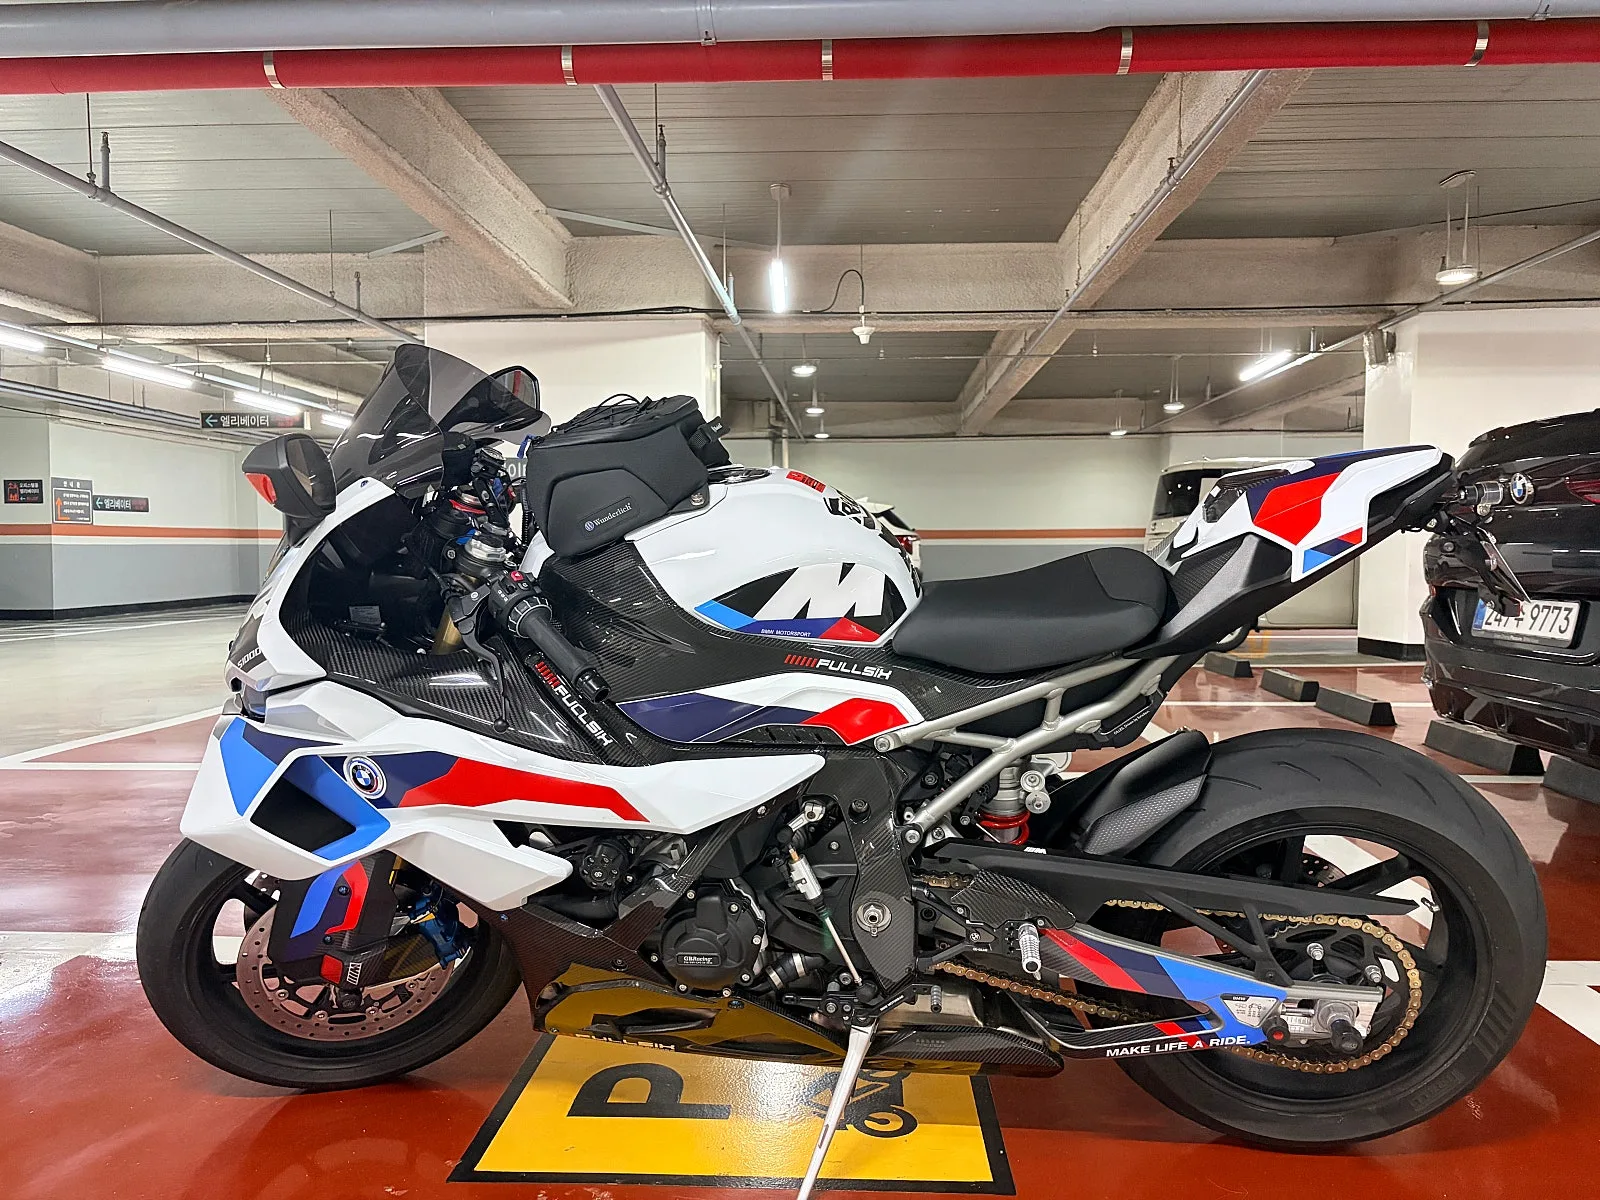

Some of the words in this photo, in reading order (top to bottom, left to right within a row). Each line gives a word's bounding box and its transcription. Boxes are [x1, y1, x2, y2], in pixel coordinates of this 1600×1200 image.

[220, 414, 269, 427] 엘리베이터
[103, 498, 132, 510] 엘리베이터
[594, 502, 632, 527] Wunderlich
[753, 562, 886, 620] M
[1529, 603, 1573, 634] 9773
[1106, 1045, 1150, 1057] MAKE
[1155, 1041, 1188, 1053] LIFE
[1192, 1040, 1203, 1049] A
[1209, 1035, 1251, 1047] RIDE.
